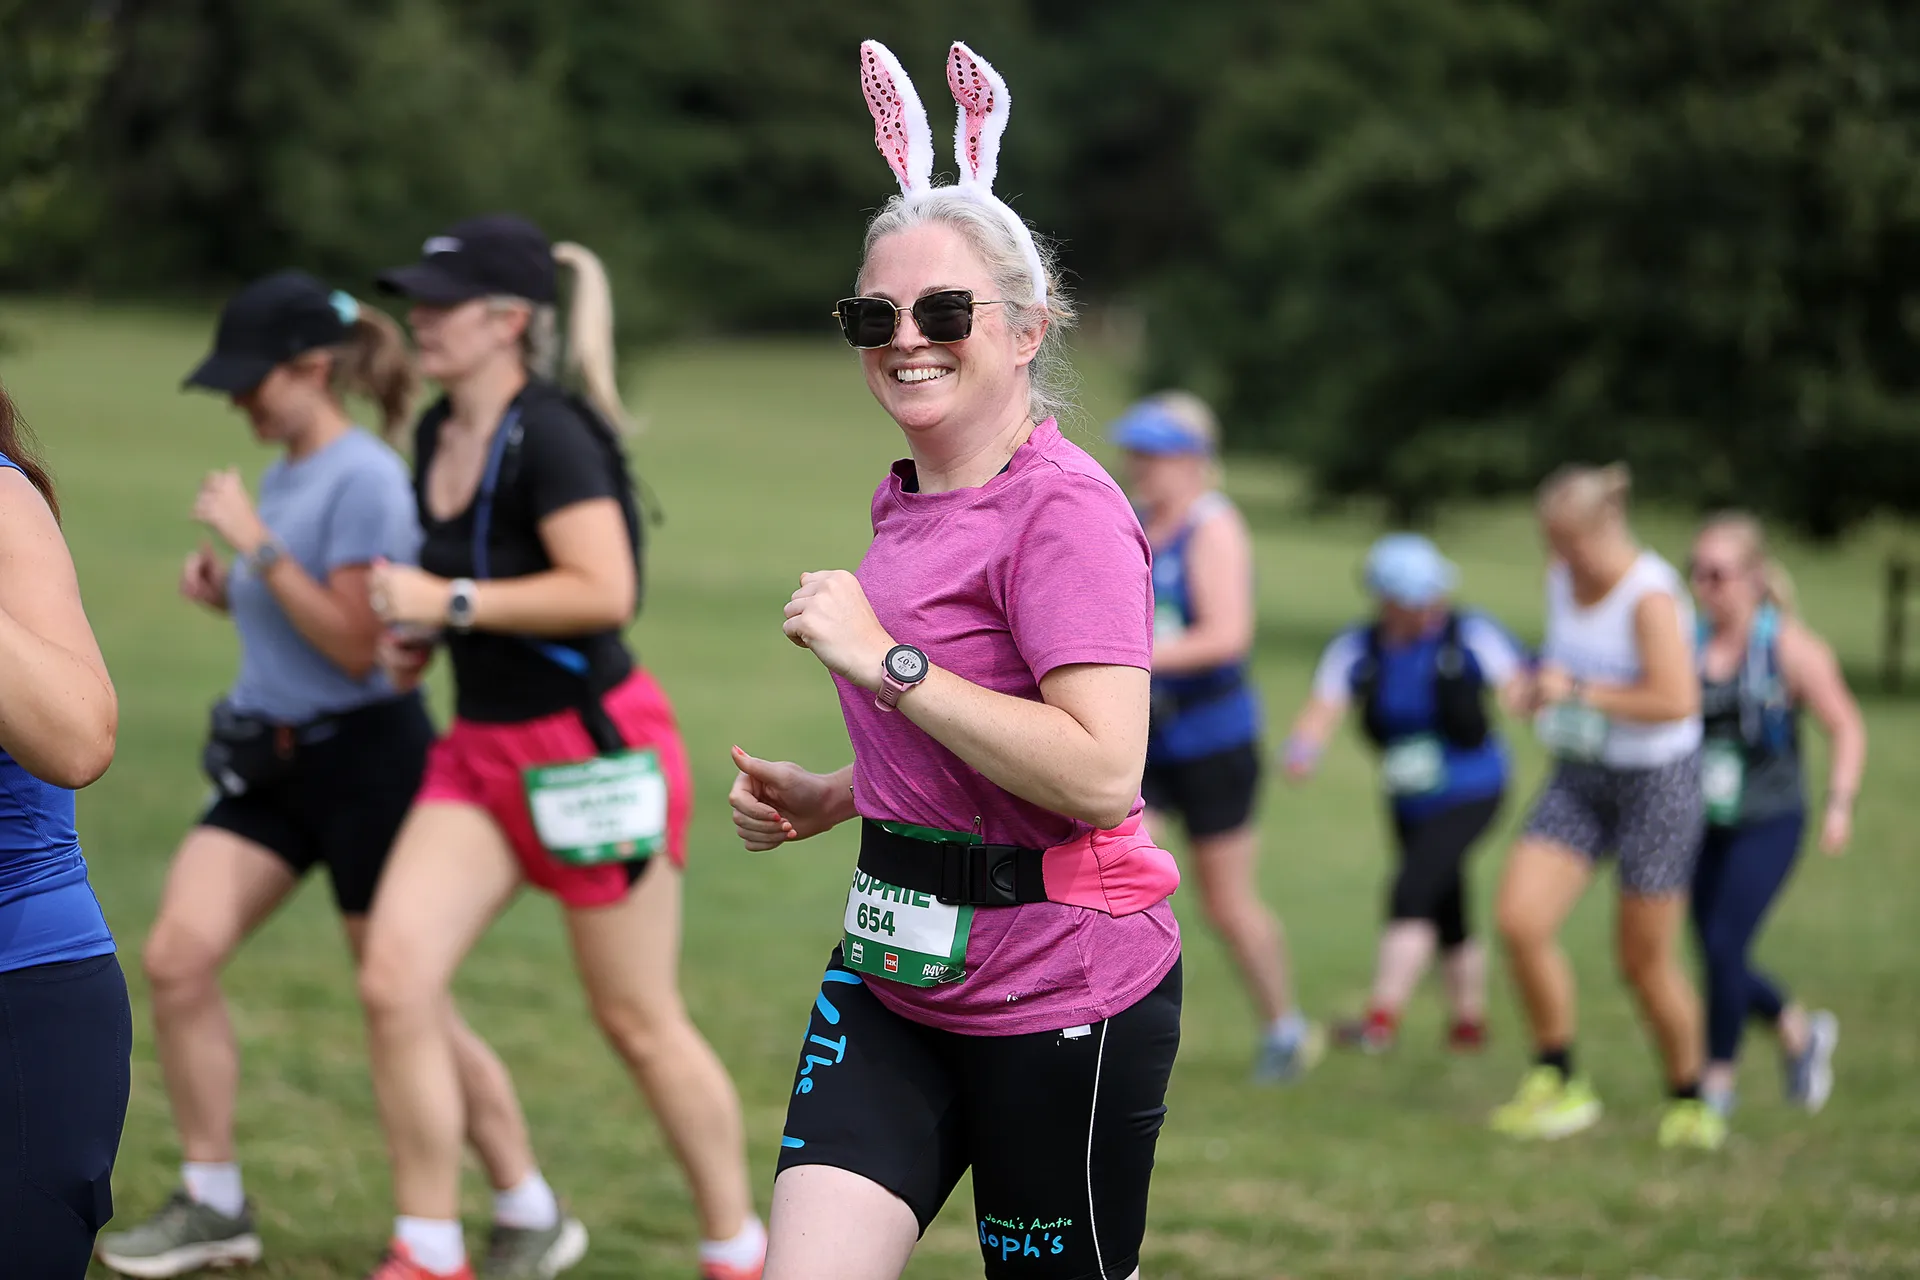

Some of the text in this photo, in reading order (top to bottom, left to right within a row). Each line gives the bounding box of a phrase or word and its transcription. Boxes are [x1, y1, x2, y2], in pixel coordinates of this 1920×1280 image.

[897, 656, 917, 669] 4:07
[857, 902, 895, 936] 654
[796, 1034, 847, 1095] The
[985, 1213, 1073, 1231] Jonah's Auntie
[980, 1220, 1064, 1261] Soph's
